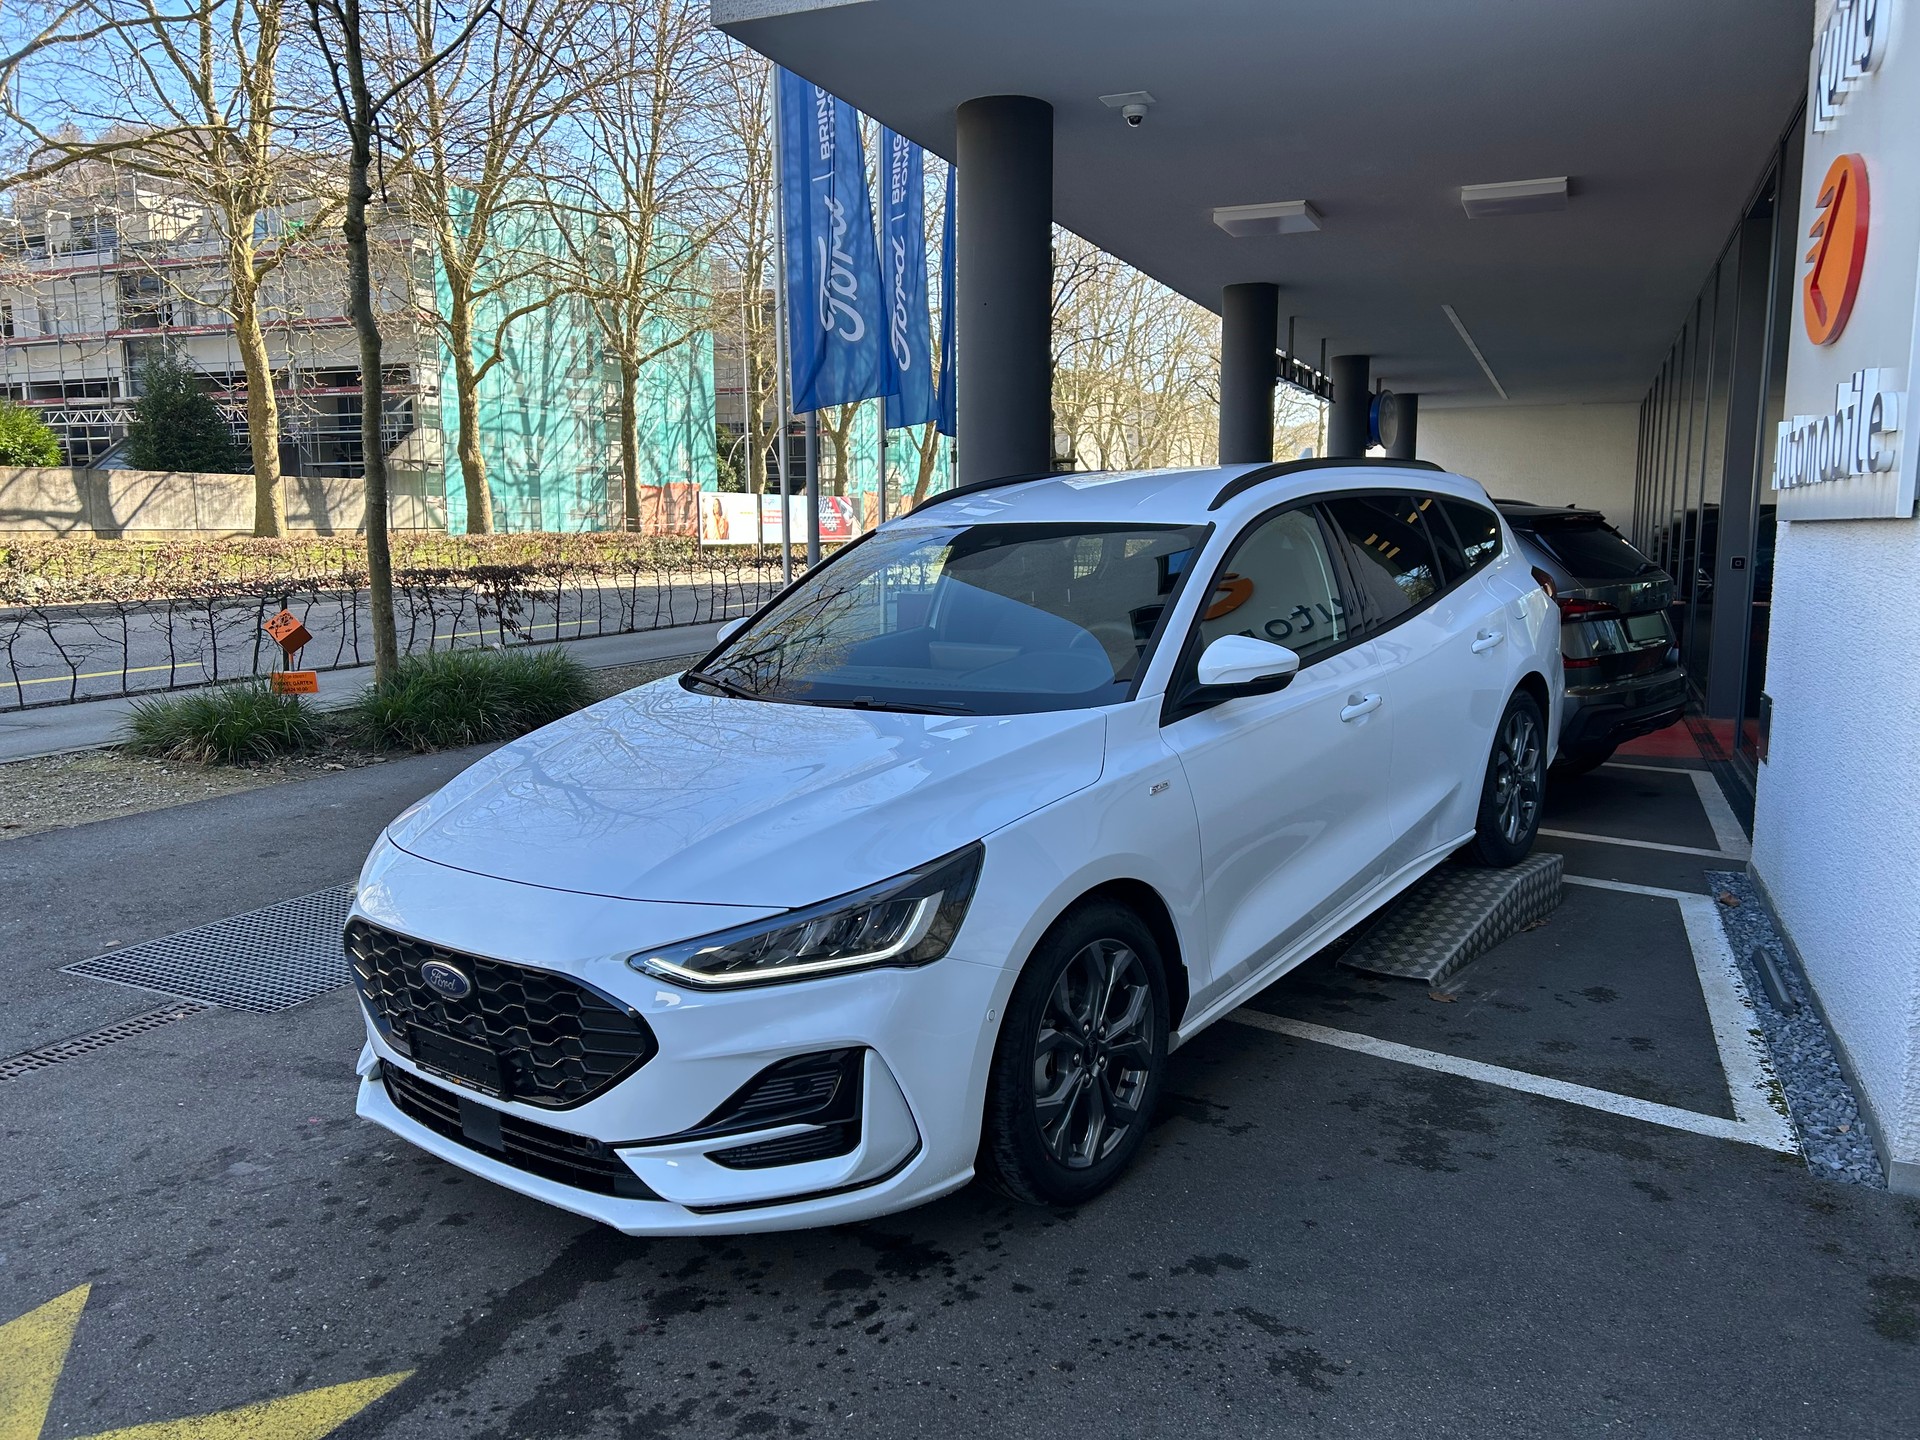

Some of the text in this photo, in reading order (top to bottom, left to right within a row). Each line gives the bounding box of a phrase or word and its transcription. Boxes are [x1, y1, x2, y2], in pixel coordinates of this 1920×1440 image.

[815, 85, 831, 160] BRING
[892, 134, 902, 205] BRING
[892, 235, 911, 371] Ford
[1771, 367, 1899, 490] utomobile
[430, 968, 457, 991] Ford
